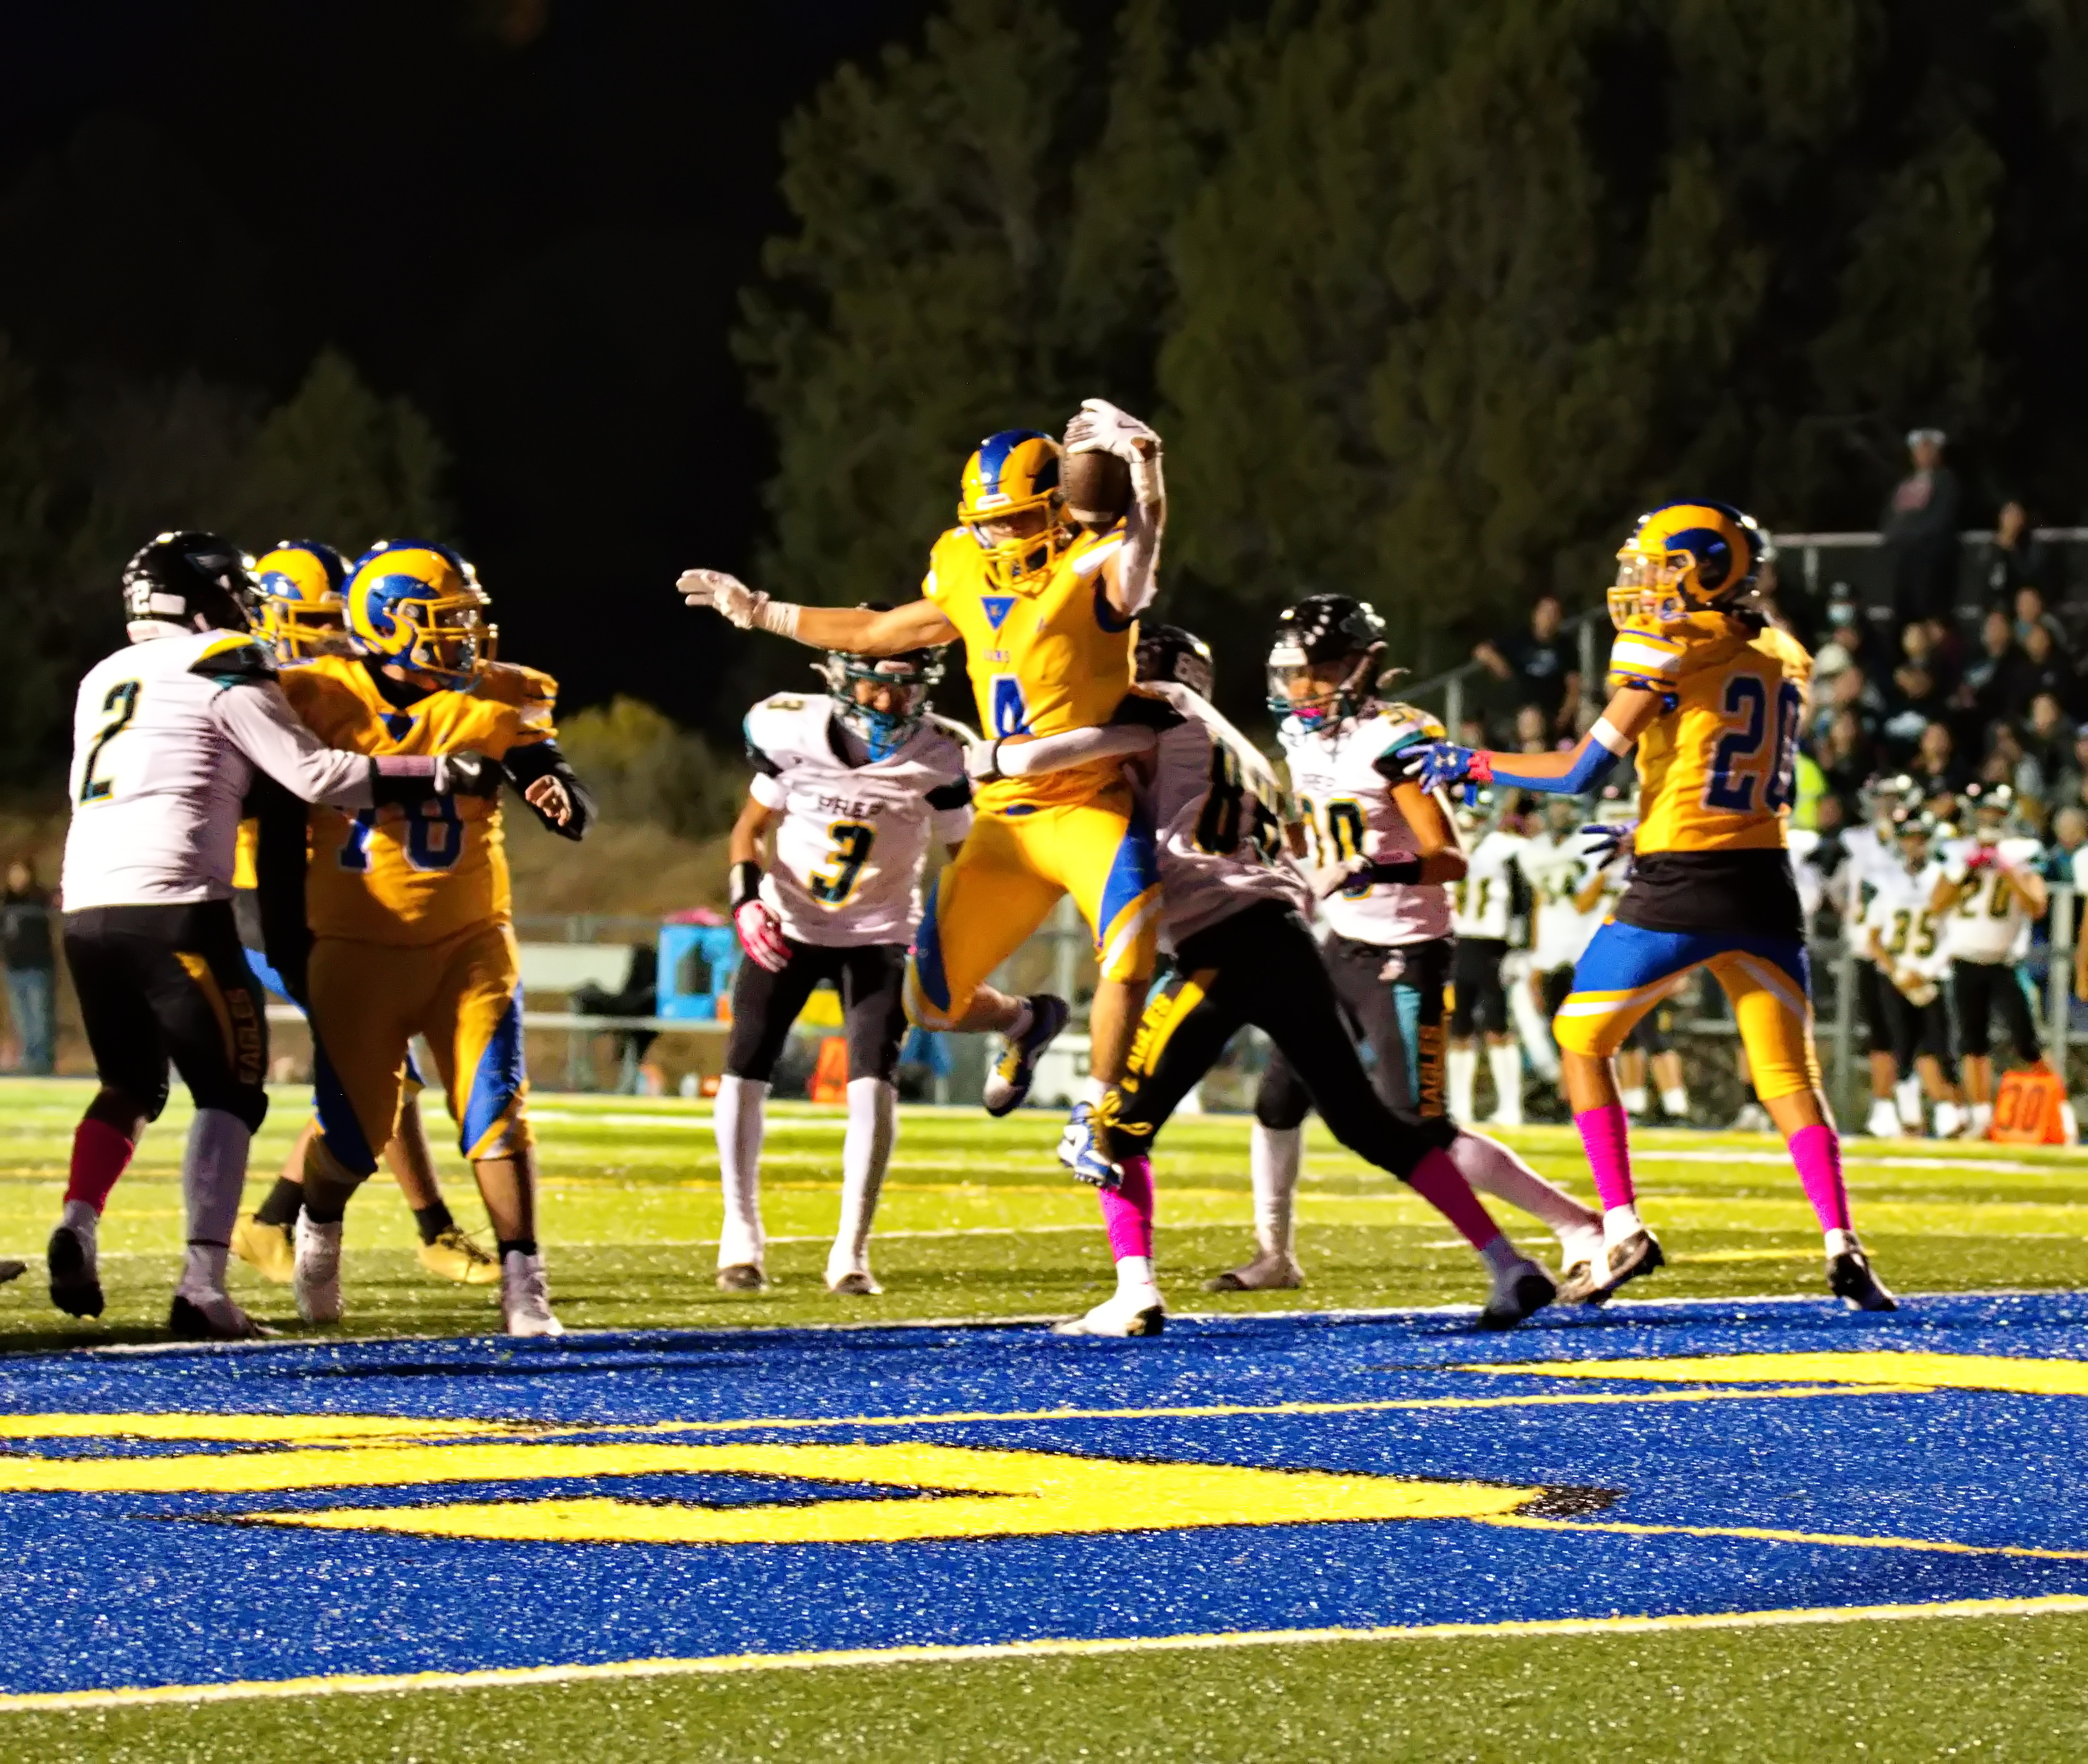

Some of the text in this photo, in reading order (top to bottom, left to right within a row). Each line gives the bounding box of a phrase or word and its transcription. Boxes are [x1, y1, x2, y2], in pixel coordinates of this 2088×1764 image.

[131, 580, 151, 614] 2
[79, 678, 142, 806] 2
[1702, 670, 1802, 814] 20
[807, 820, 877, 907] 3
